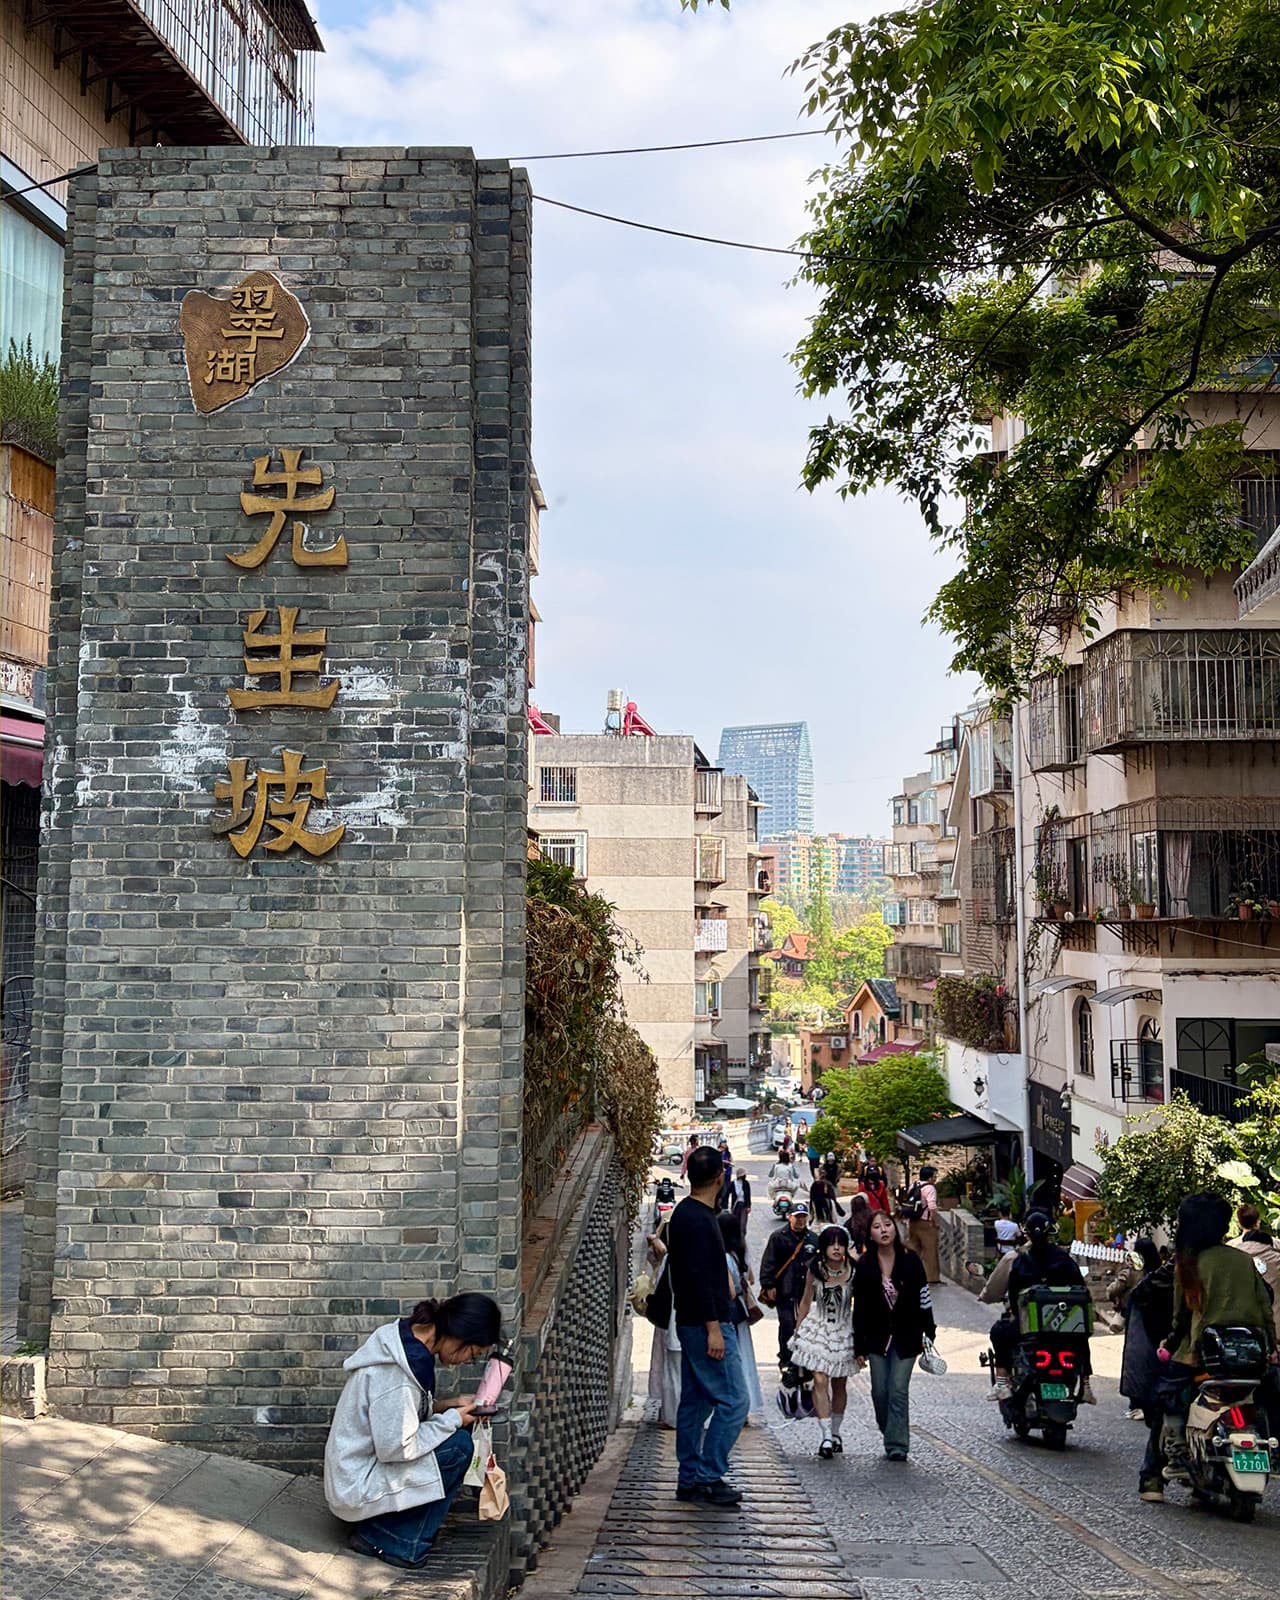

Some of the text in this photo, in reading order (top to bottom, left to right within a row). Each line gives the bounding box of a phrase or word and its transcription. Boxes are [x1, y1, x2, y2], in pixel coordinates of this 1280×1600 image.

[204, 285, 285, 384] 翠湖
[212, 448, 348, 859] 先生坡
